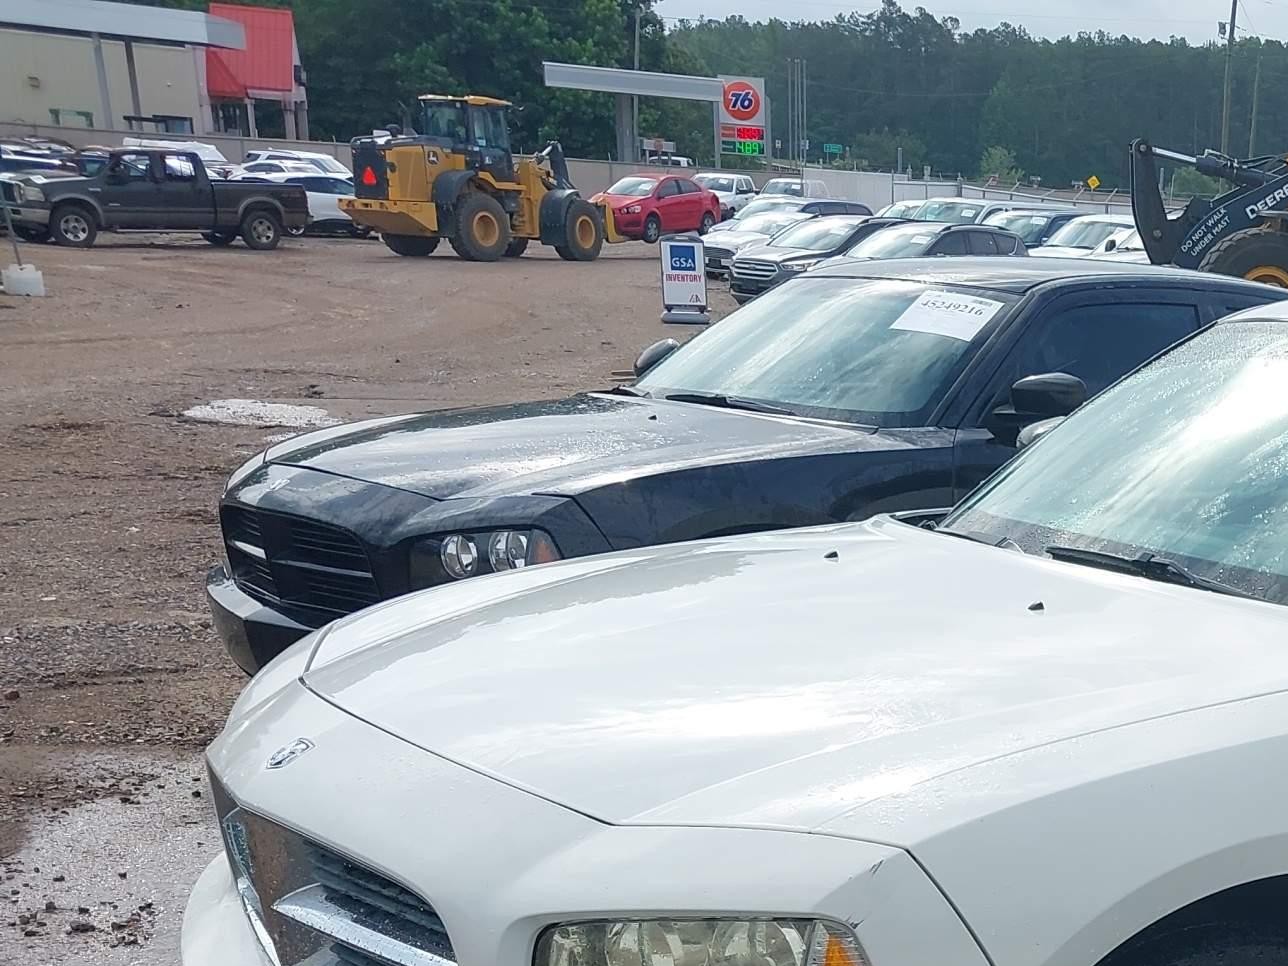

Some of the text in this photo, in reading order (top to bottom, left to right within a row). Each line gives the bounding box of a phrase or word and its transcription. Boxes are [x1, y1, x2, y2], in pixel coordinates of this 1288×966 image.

[730, 90, 754, 111] 76
[1180, 207, 1228, 252] DO NOT WALK
[1190, 216, 1231, 257] UNDER MAST
[671, 257, 695, 268] GSA
[665, 273, 702, 283] INVENTORY
[921, 299, 984, 317] 45249216
